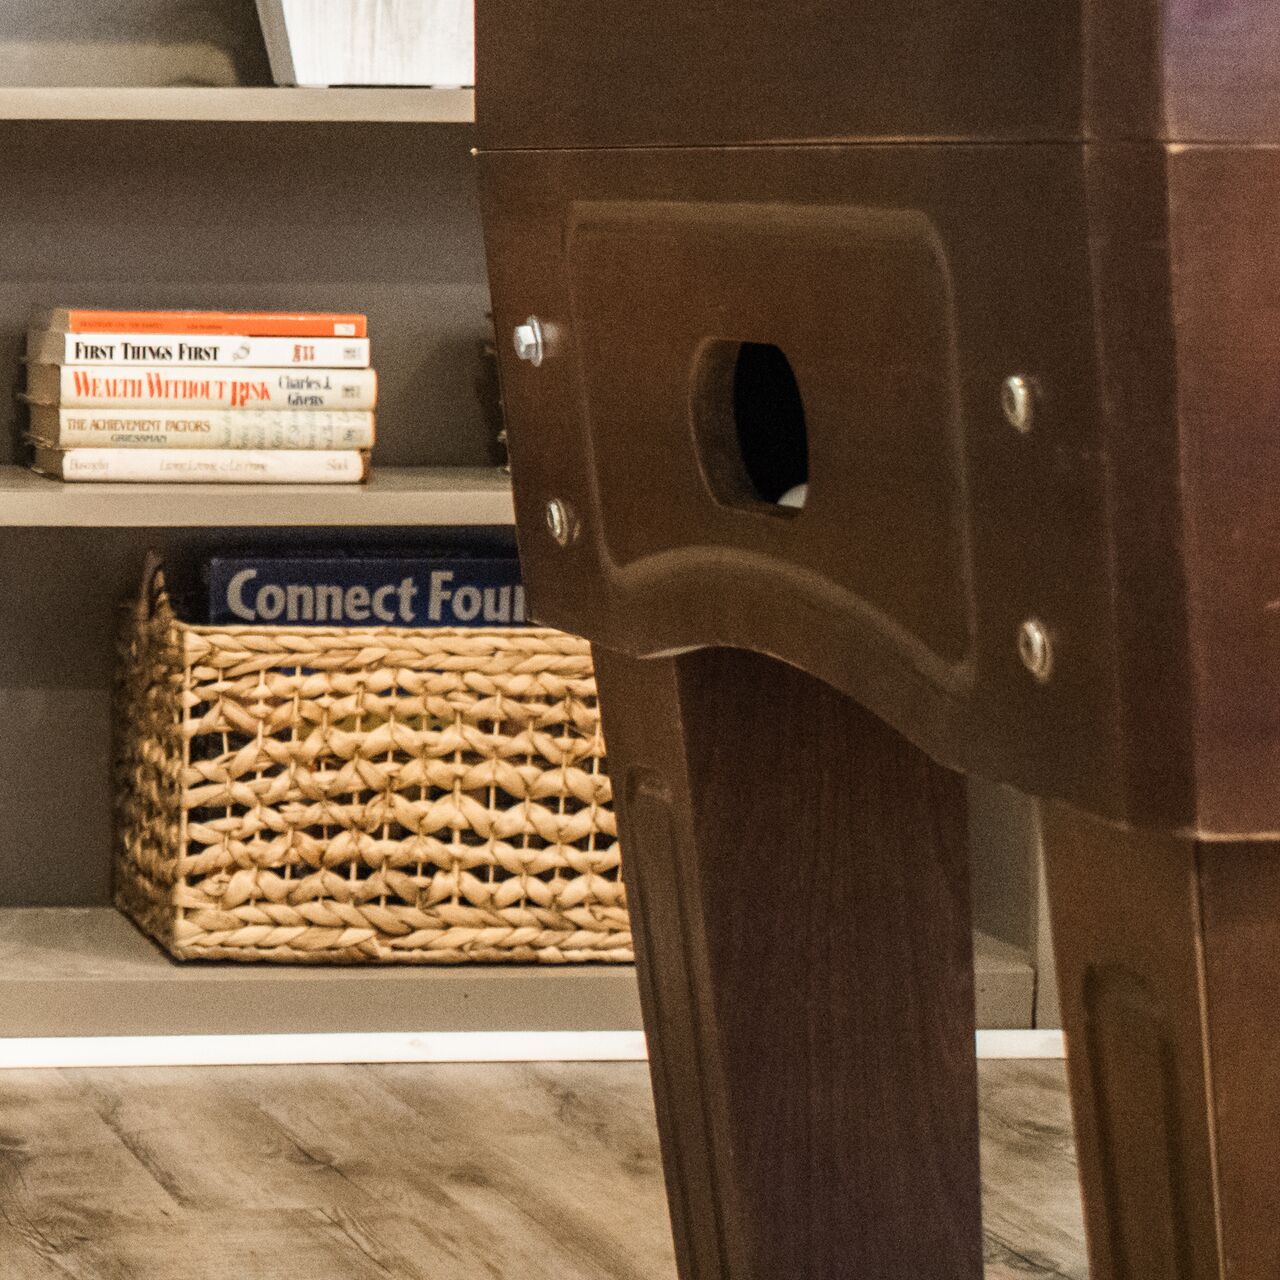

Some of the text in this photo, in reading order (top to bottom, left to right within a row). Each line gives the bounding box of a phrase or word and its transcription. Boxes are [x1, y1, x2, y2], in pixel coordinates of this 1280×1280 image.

[75, 341, 220, 361] FIRST THINGS FIRST
[73, 371, 271, 407] WEALTH WITHOUT RISK
[278, 376, 321, 390] Charles
[287, 392, 324, 406] Givens
[67, 419, 211, 433] THE ACHIEVEMENT FACTORS
[111, 434, 167, 443] GRIESSMAN
[227, 569, 418, 622] Connect
